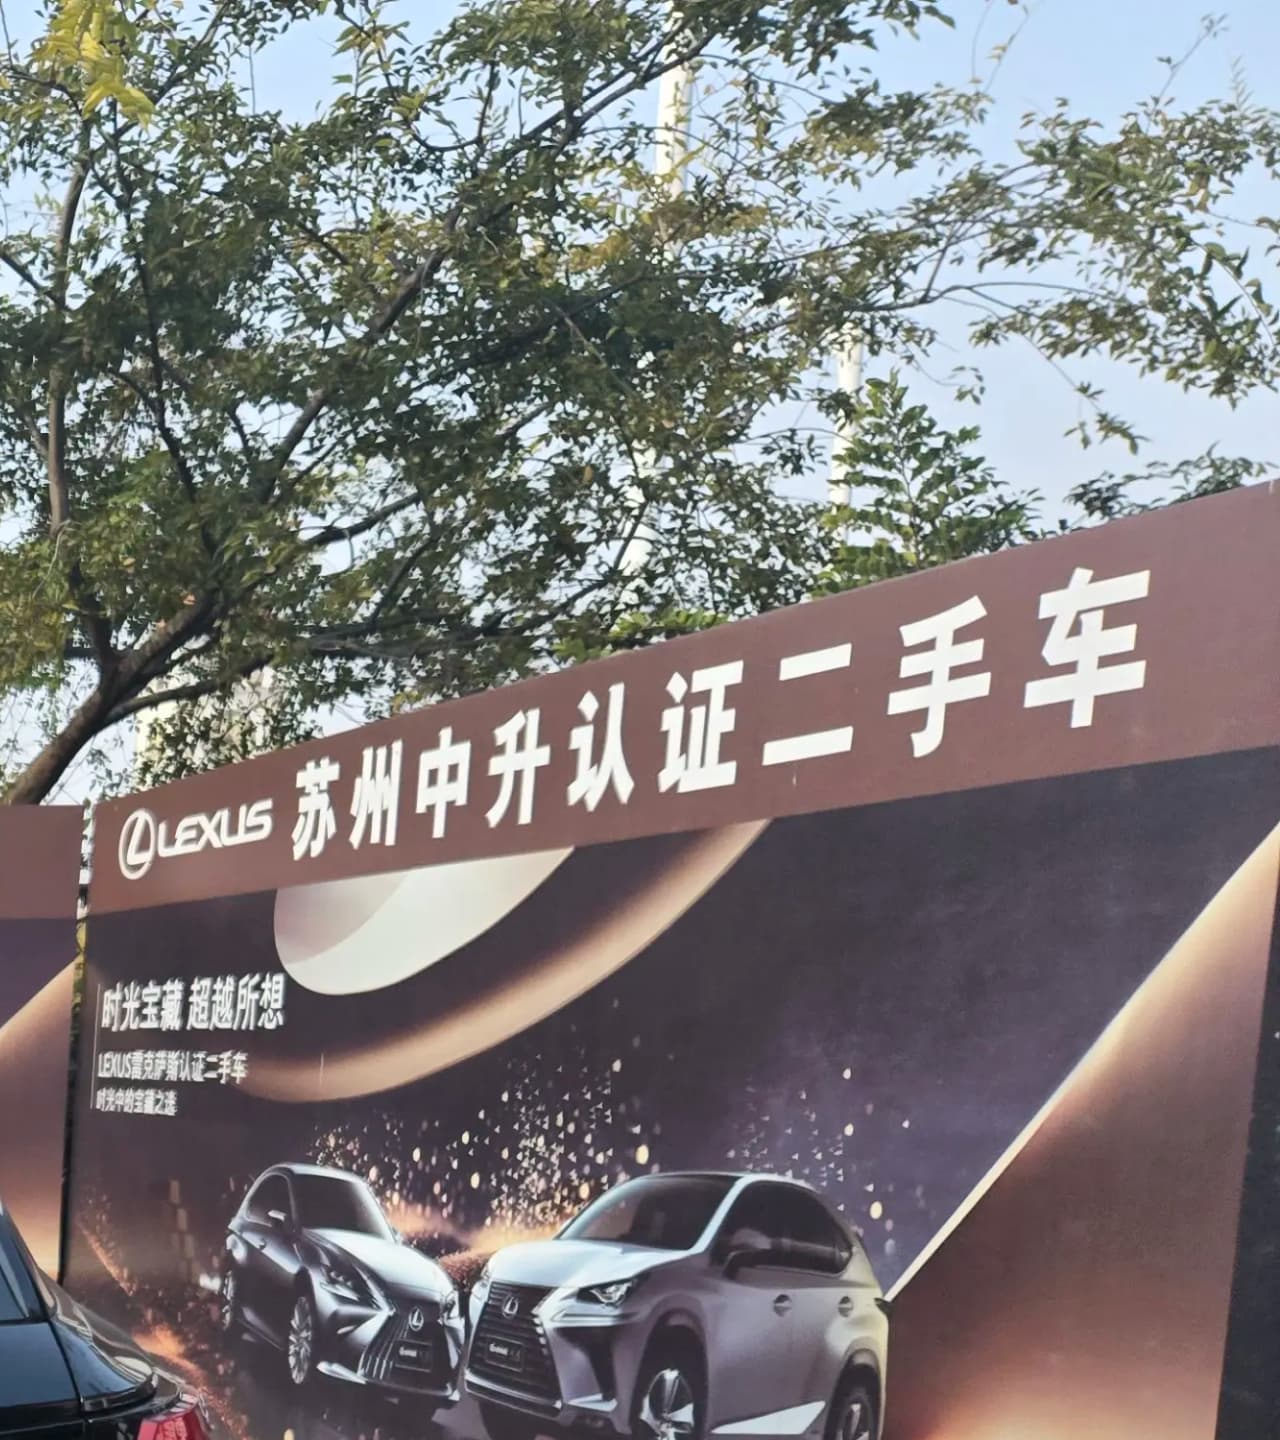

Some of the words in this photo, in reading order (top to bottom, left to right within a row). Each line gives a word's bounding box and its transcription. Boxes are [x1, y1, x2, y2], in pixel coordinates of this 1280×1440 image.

[291, 566, 1152, 862] 苏州中升认证二手车
[157, 798, 274, 857] LEXUS
[101, 978, 185, 1032] 时光宝藏
[186, 972, 286, 1031] 超越所想
